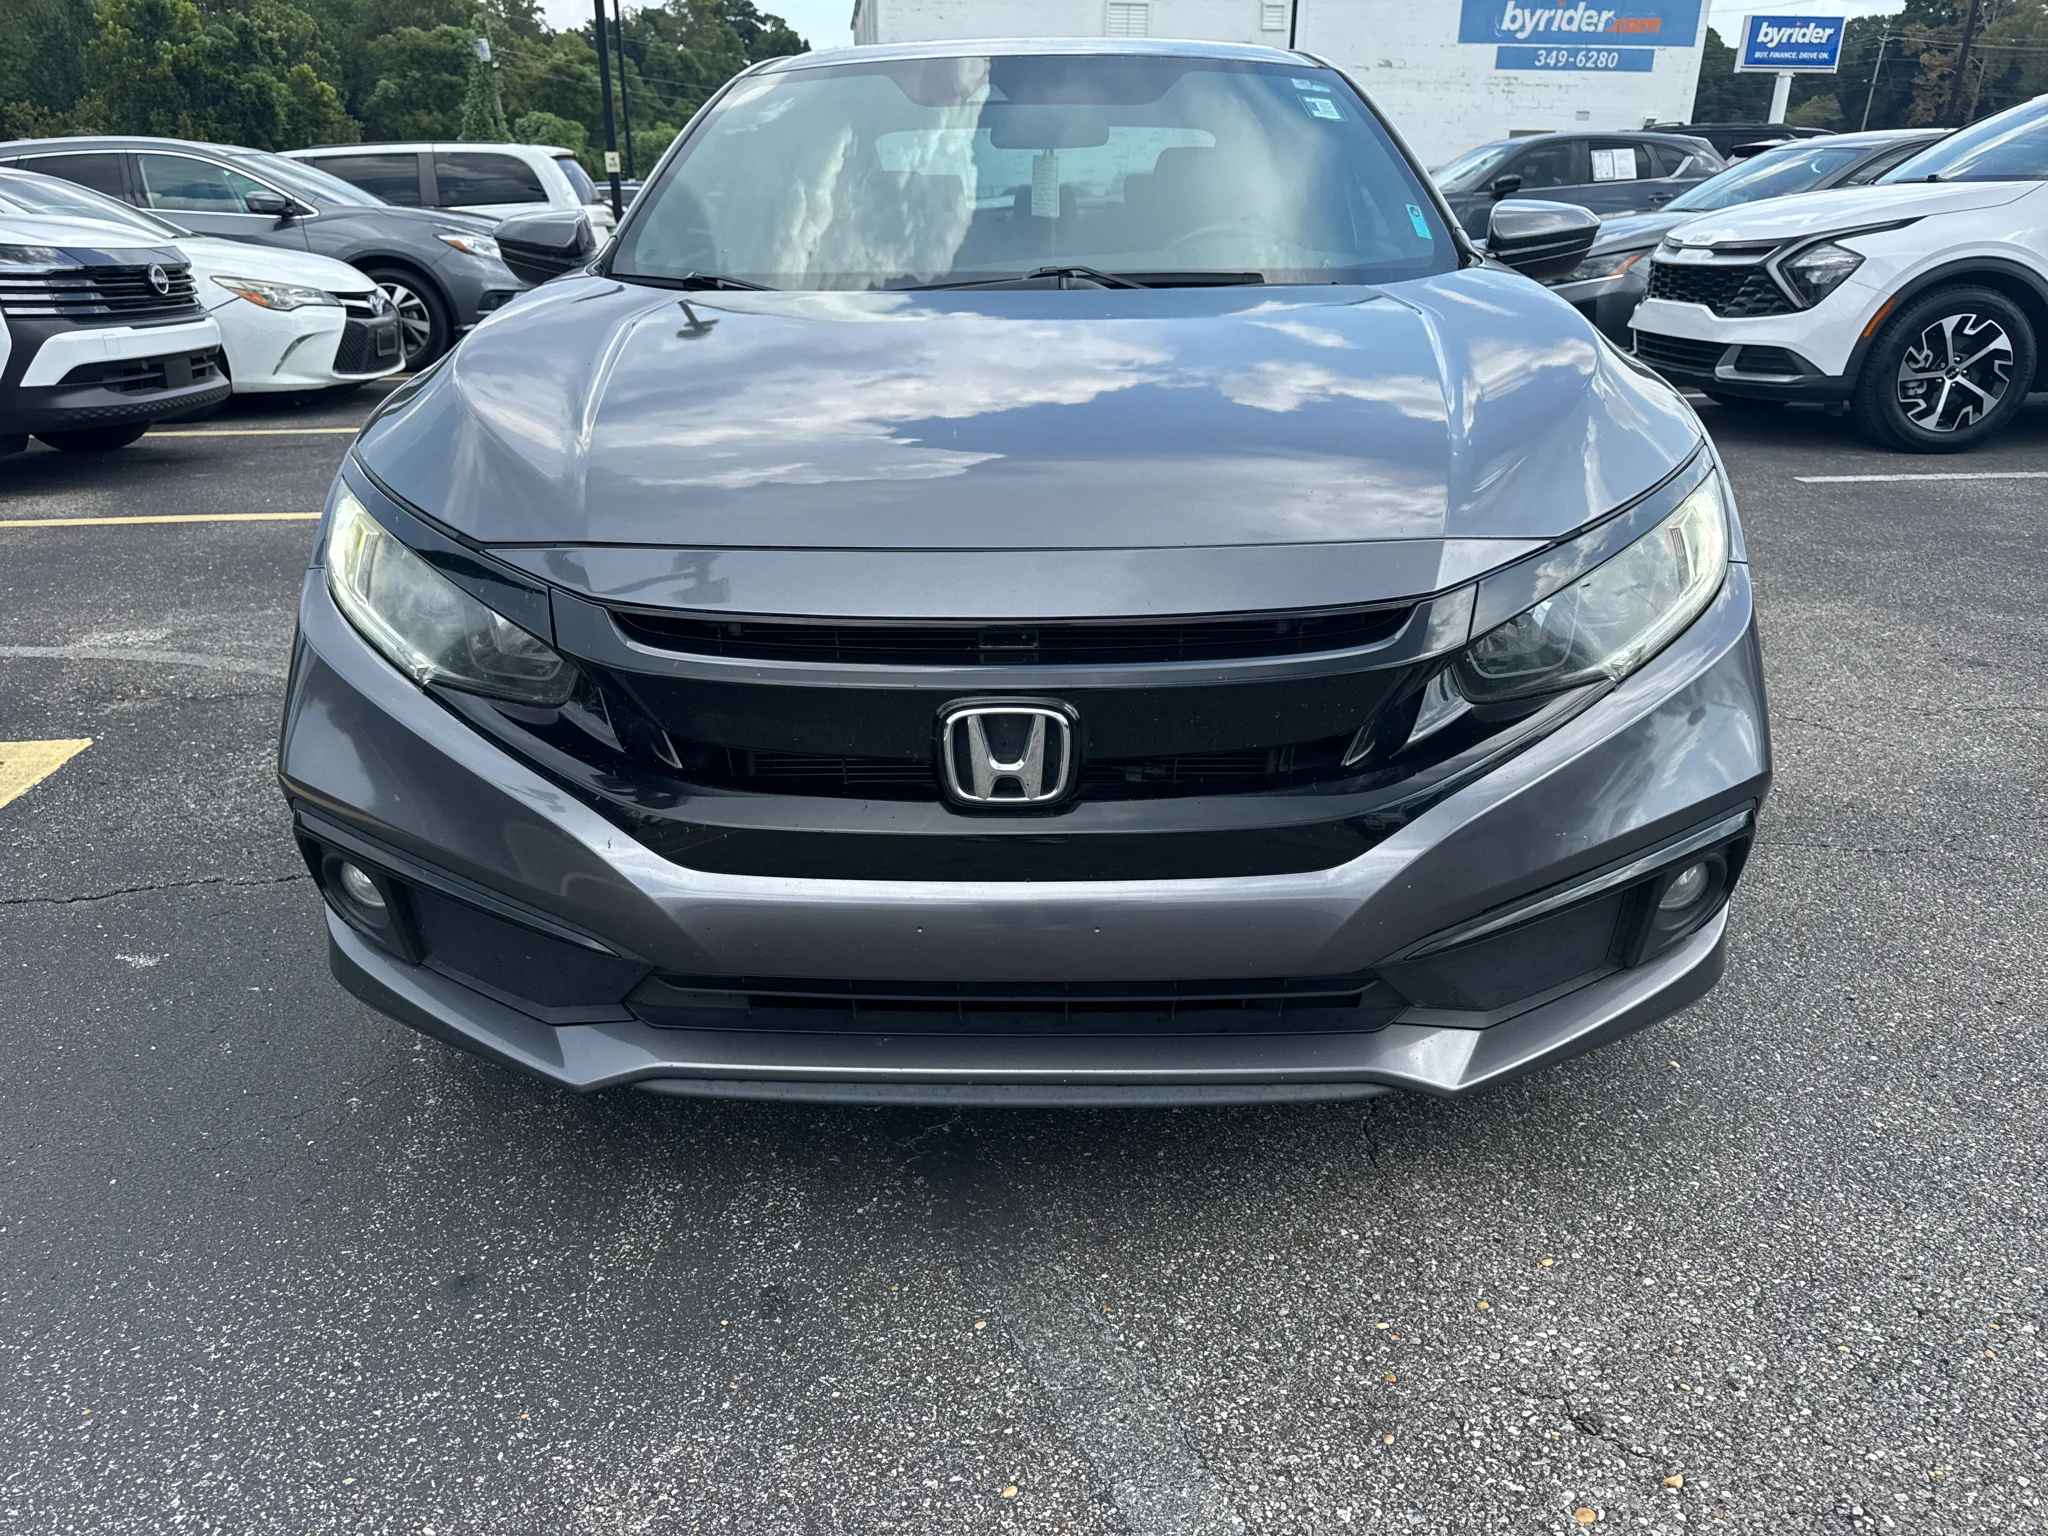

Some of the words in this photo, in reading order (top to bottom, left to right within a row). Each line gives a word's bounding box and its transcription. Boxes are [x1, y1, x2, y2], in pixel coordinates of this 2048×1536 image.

[1500, 0, 1661, 39] byrider.com
[1756, 21, 1835, 48] byrider
[1534, 50, 1619, 68] 349-6280
[1798, 52, 1818, 60] DRIVE
